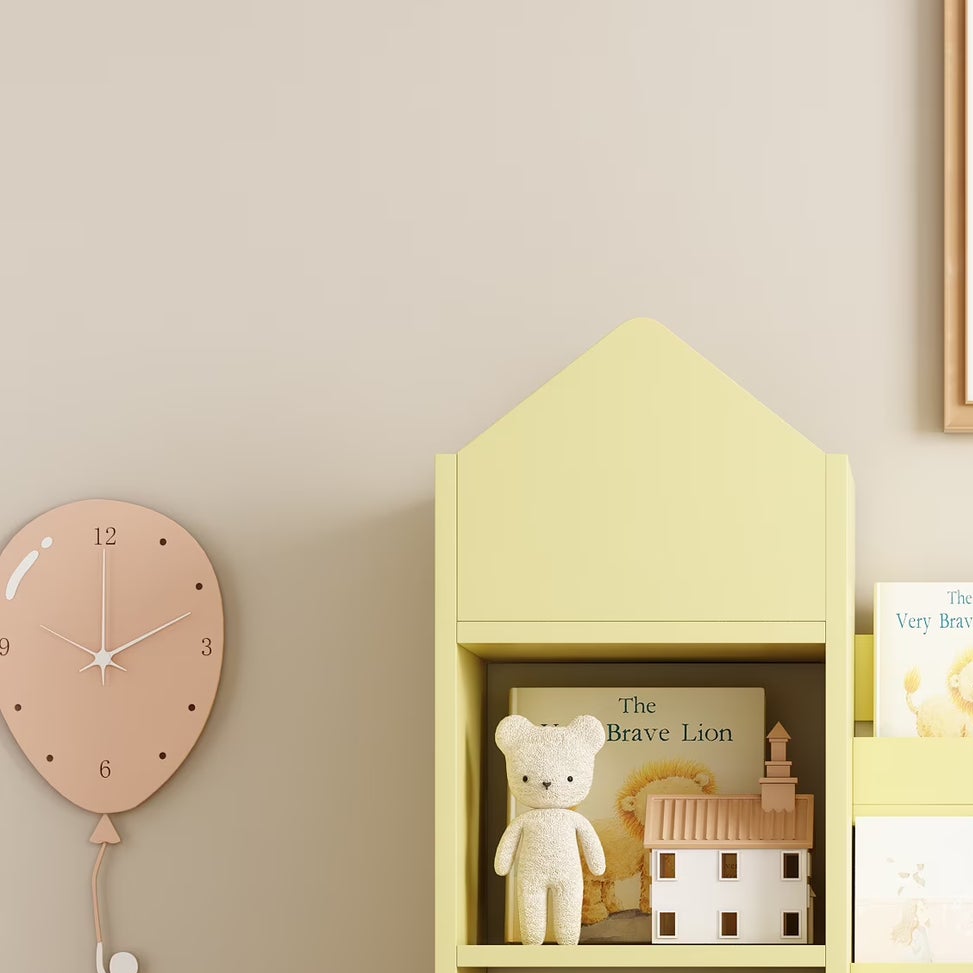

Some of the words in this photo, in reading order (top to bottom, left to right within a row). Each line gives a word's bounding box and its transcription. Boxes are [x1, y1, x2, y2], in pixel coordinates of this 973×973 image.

[94, 527, 117, 546] 12
[947, 589, 973, 605] The
[896, 612, 931, 635] Very
[0, 637, 10, 656] 9
[201, 637, 213, 656] 3
[618, 695, 657, 714] The
[606, 722, 670, 742] Brave
[681, 722, 734, 742] Lion
[99, 760, 111, 779] 6
